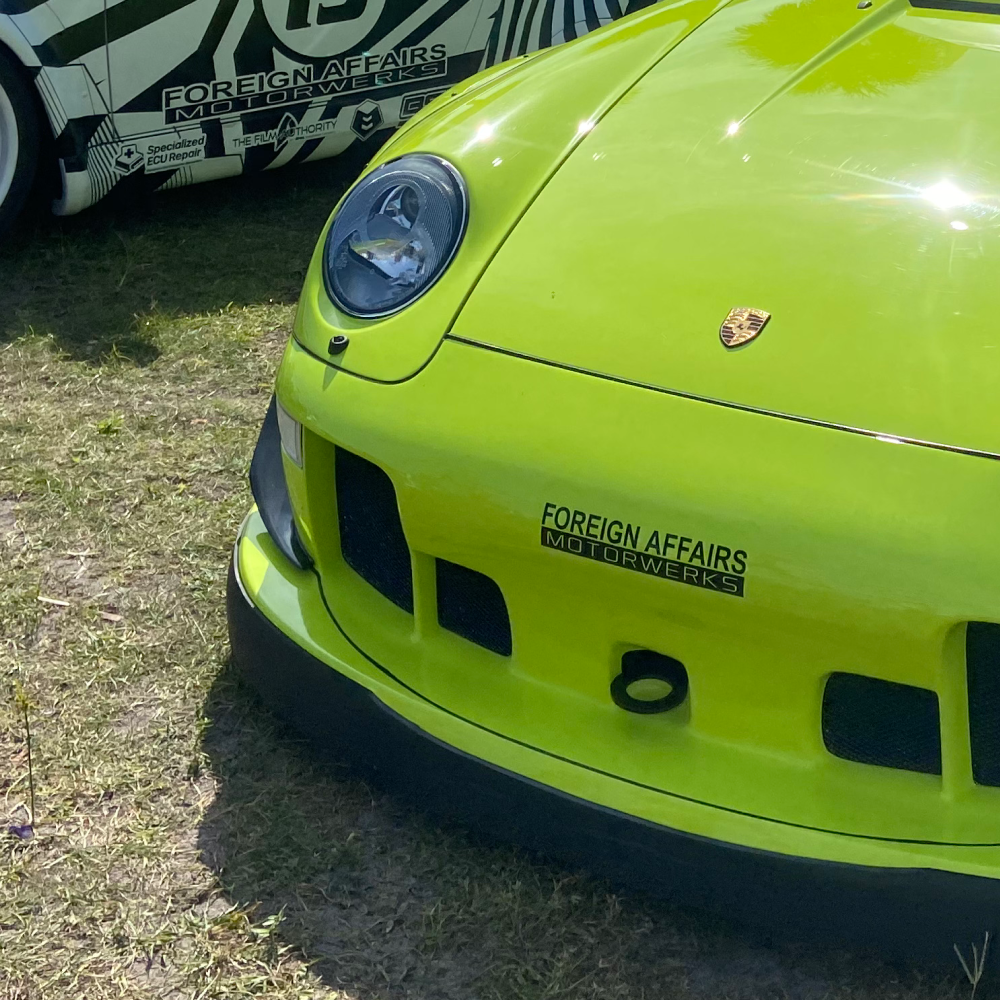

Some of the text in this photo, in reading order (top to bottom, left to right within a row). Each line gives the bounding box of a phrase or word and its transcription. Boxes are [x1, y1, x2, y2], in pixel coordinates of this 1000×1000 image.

[164, 44, 447, 108] FOREIGN AFFAIRS
[175, 63, 439, 121] MOTORWERKS
[146, 136, 205, 155] Specialized
[146, 148, 202, 166] ECU Repair
[232, 136, 251, 148] THE
[541, 502, 748, 575] FOREIGN AFFAIRS
[545, 530, 738, 594] MOTORWERKS
